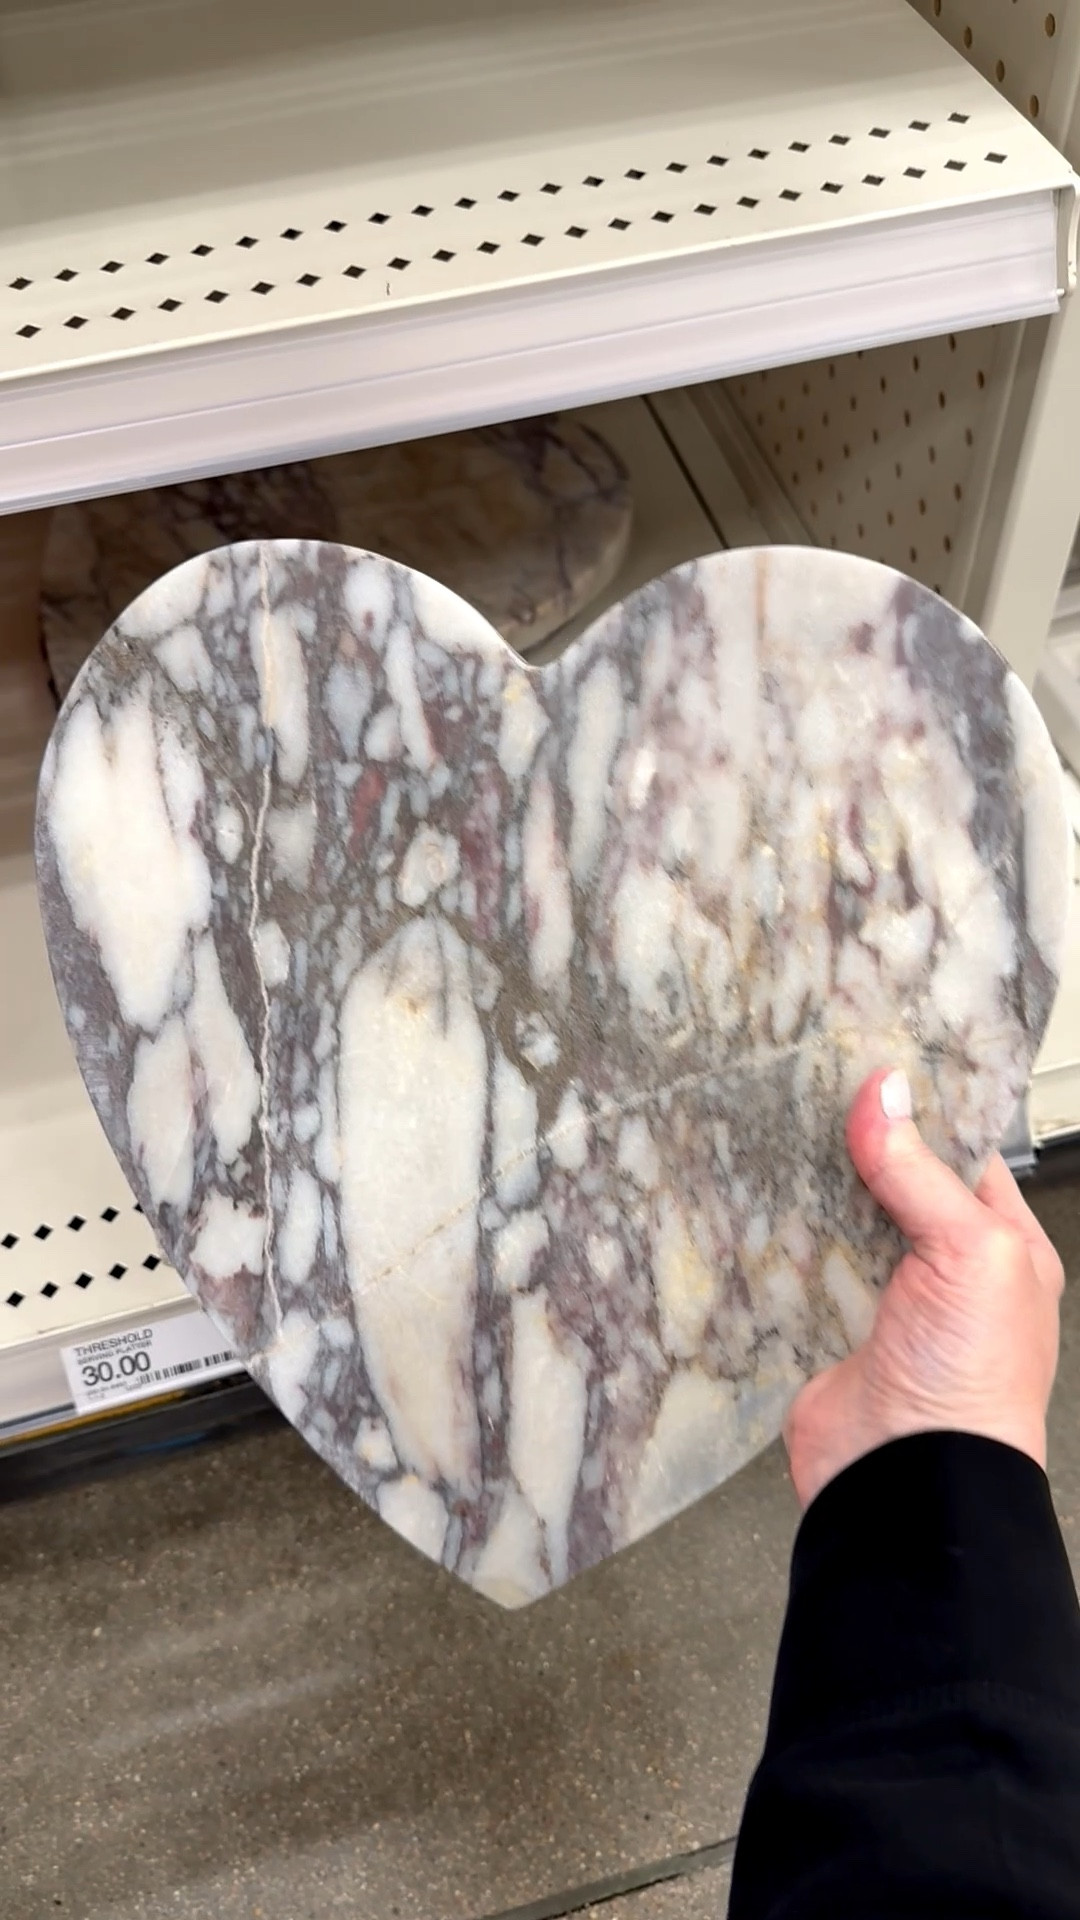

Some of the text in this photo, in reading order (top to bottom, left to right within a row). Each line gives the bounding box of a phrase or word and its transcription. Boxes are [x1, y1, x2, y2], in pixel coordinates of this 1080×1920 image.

[75, 1328, 153, 1357] THRESHOLD
[116, 1341, 152, 1354] PLATTER
[82, 1351, 150, 1386] 30.00
